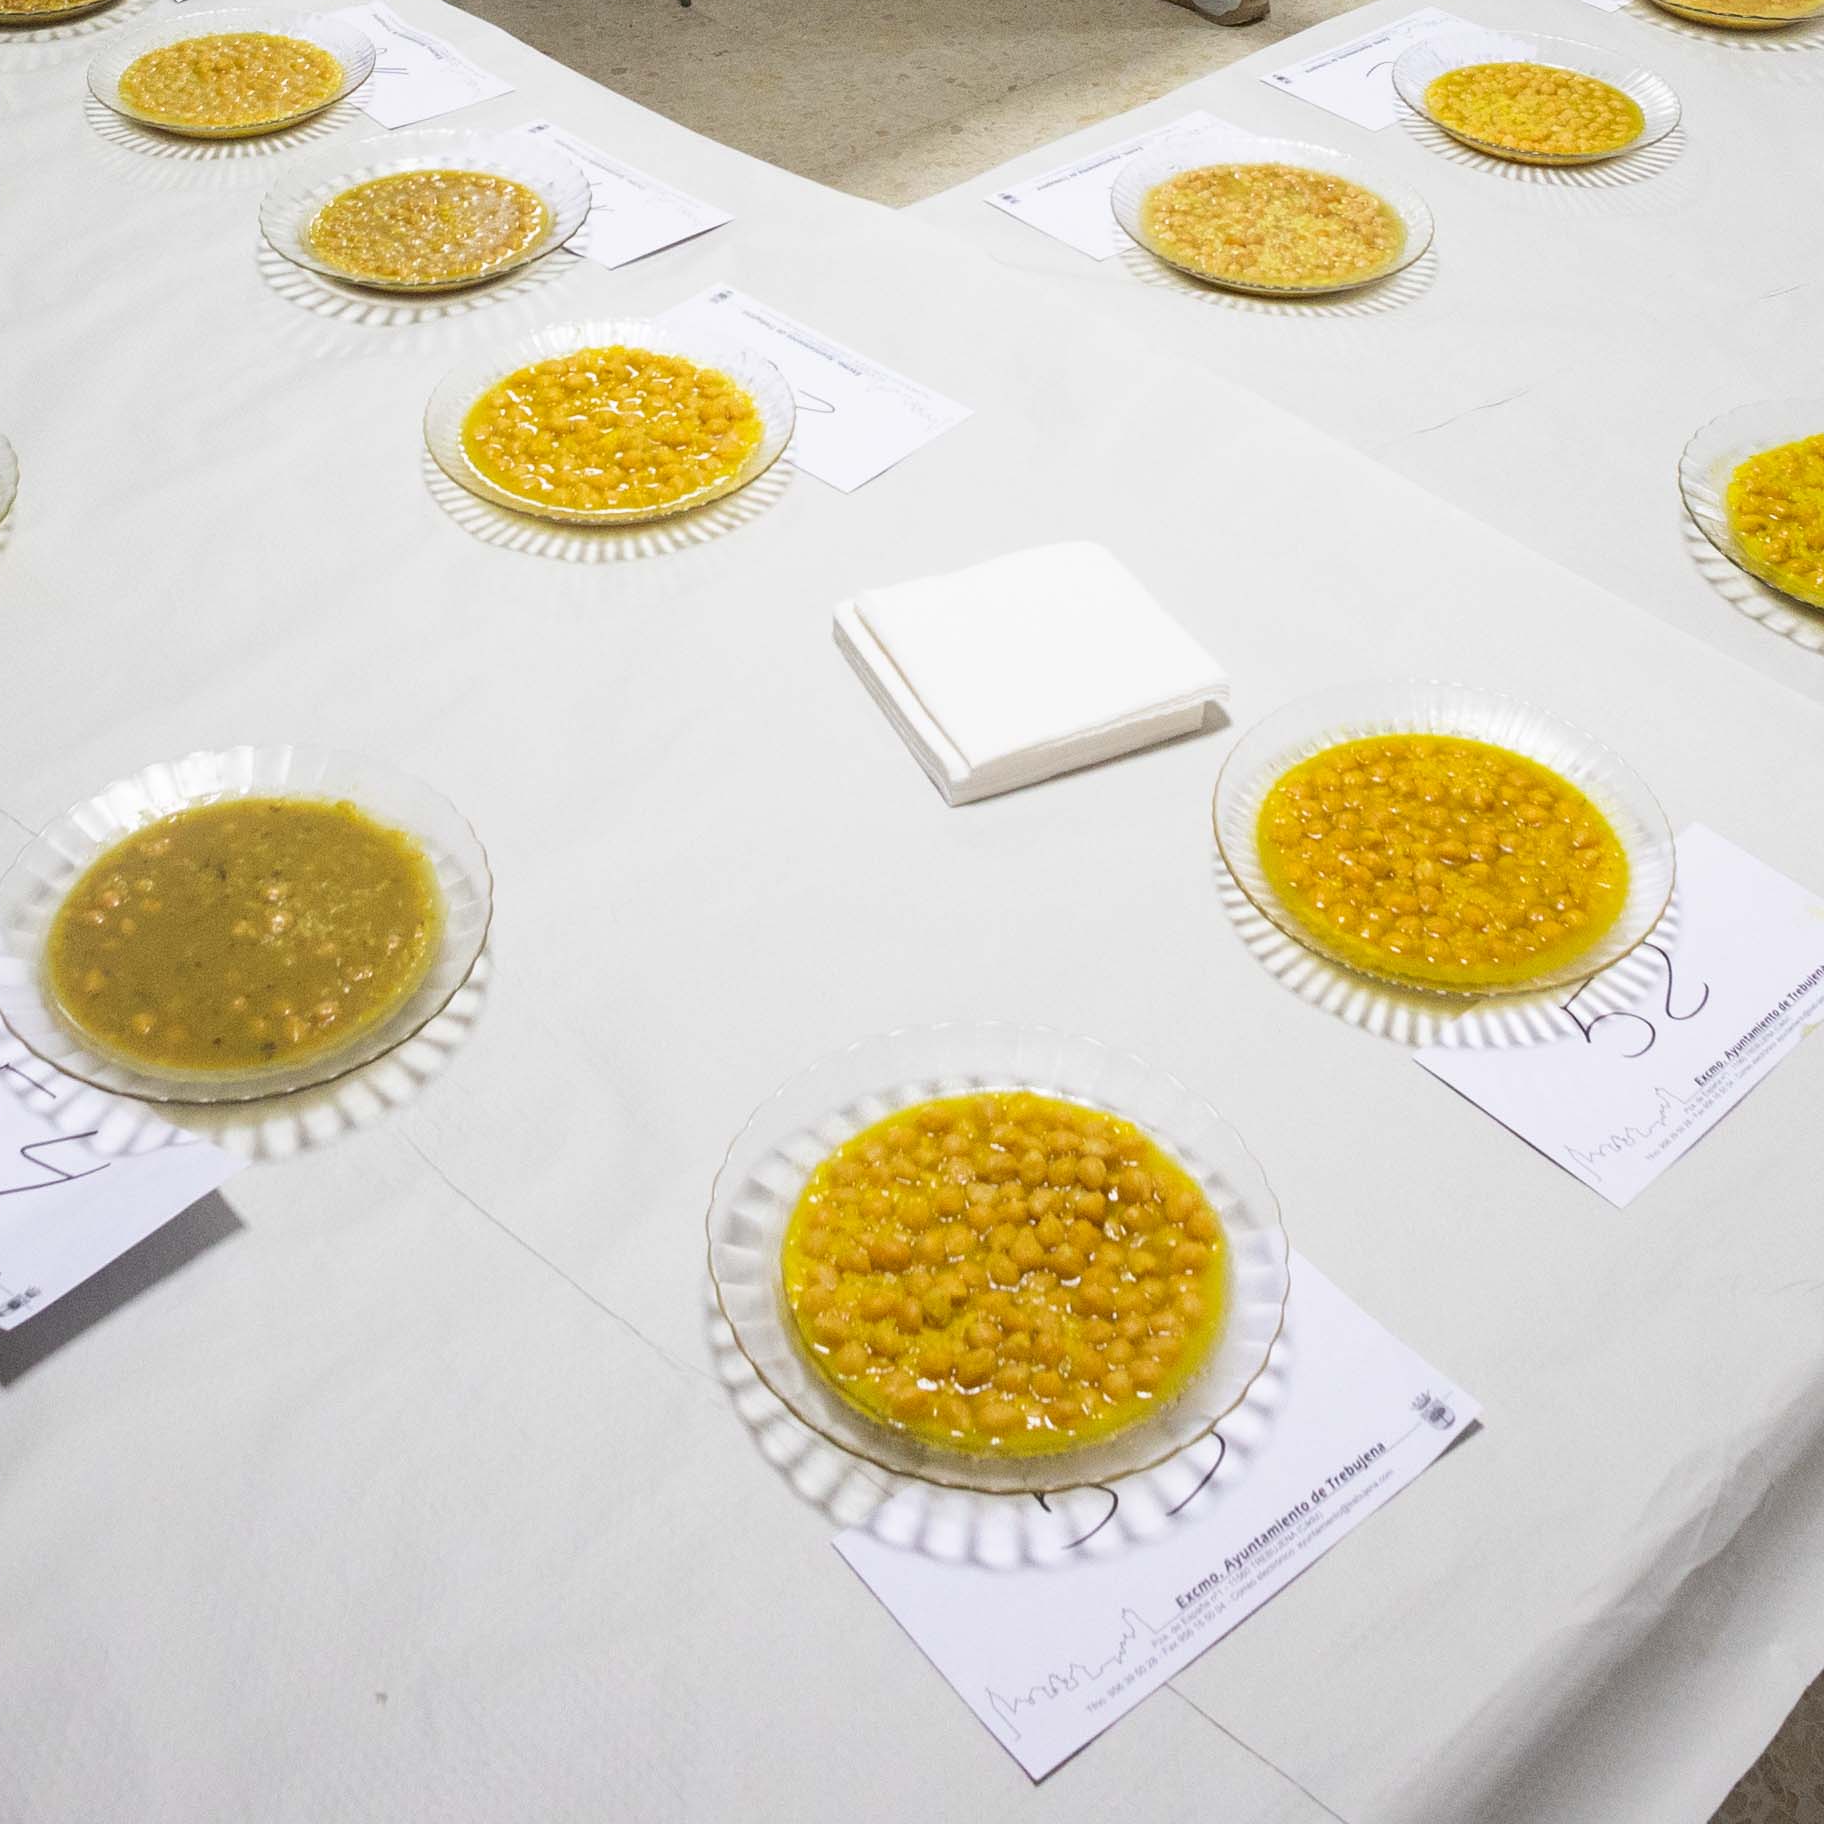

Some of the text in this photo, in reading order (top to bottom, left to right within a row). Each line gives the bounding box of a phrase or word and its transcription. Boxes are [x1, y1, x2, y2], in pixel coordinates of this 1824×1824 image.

[1559, 941, 1710, 1060] 52
[1694, 1056, 1726, 1087] Excmo.
[1725, 1008, 1780, 1061] Ayuntamiento
[1777, 998, 1789, 1010] de
[1175, 1439, 1386, 1610] Excmo. Ayuntamiento de Trebujena
